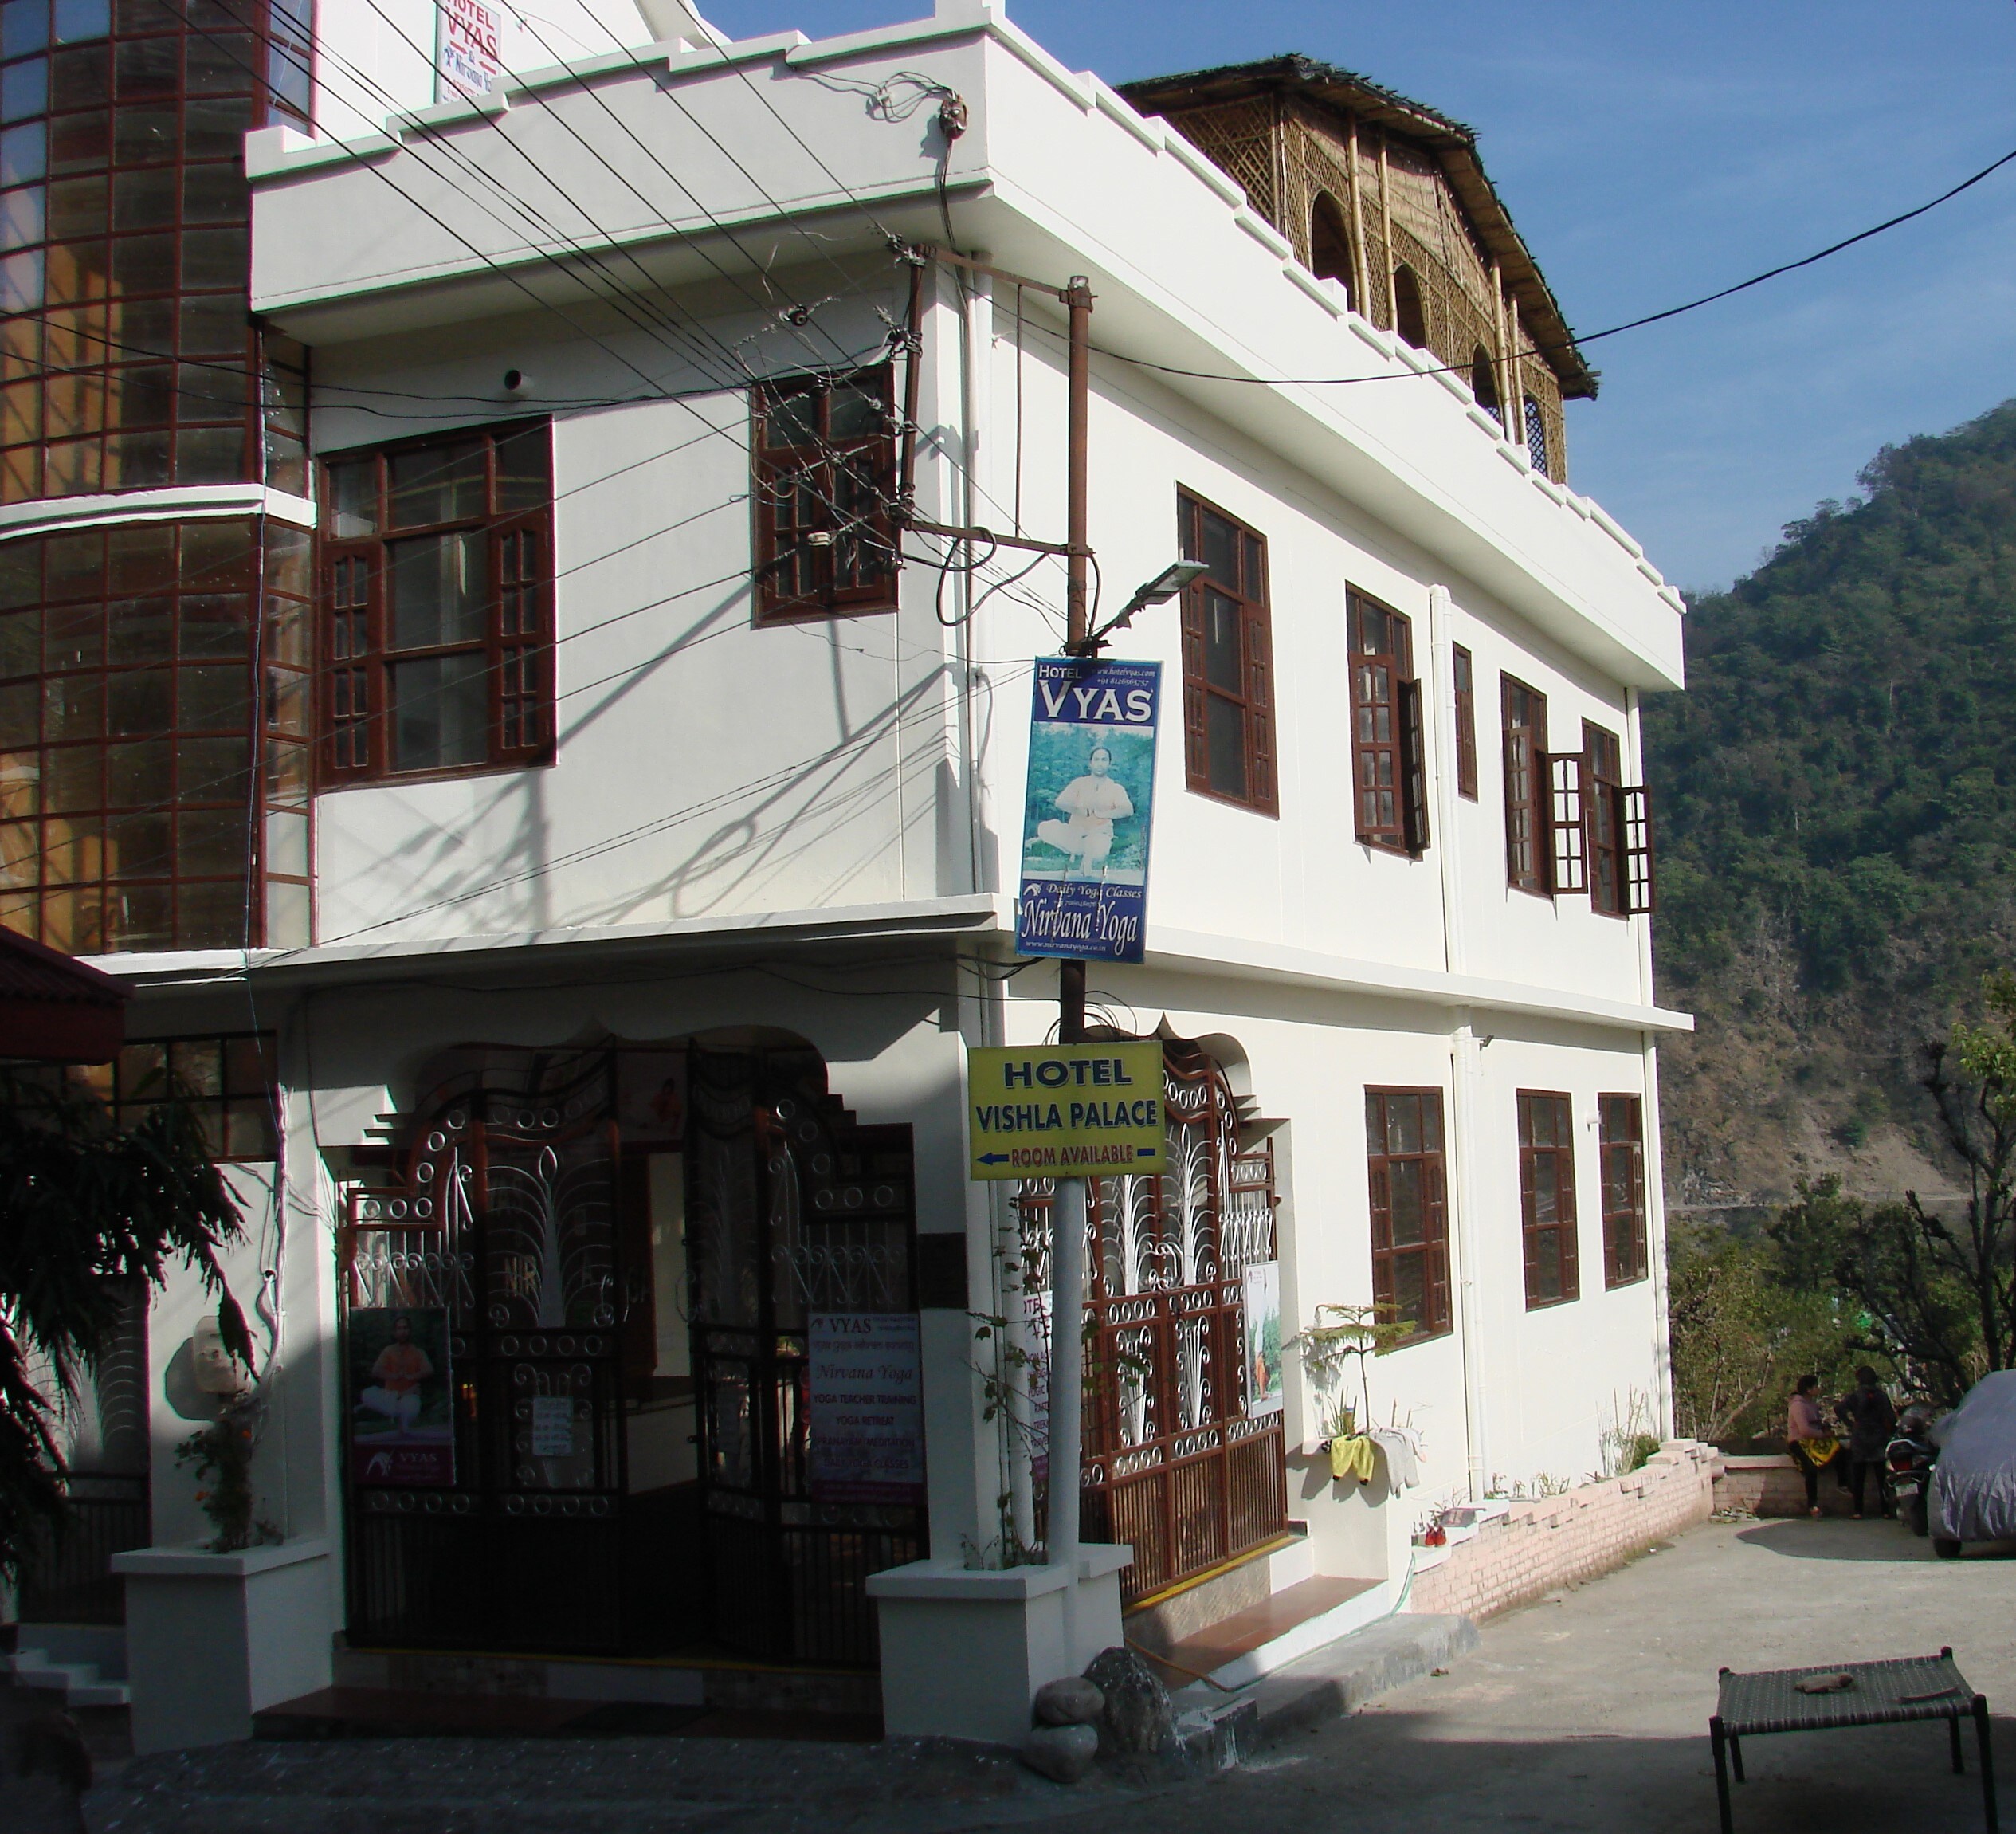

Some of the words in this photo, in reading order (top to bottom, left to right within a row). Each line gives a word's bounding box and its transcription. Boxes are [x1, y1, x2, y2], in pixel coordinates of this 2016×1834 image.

[448, 0, 495, 31] OTEL
[445, 5, 497, 62] VYAS
[1038, 664, 1083, 679] HOTEL
[1038, 679, 1153, 723] VYAS
[1046, 882, 1076, 897] Daily
[1078, 884, 1102, 900] Yoga
[1106, 886, 1143, 899] Classes
[1021, 897, 1092, 939] Nirvana
[1099, 900, 1139, 956] Yoga
[1003, 1058, 1133, 1089] HOTEL
[975, 1103, 1065, 1133] VISHLA
[1069, 1099, 1158, 1129] PALACE
[1011, 1146, 1056, 1168] ROOM
[1060, 1144, 1134, 1166] AVAILABLE
[830, 1318, 872, 1333] VYAS
[816, 1364, 873, 1380] Nirvana
[879, 1364, 912, 1384] Yoga
[814, 1394, 837, 1404] YOGA
[840, 1394, 875, 1404] TEACHER
[877, 1395, 916, 1404] TRAINING
[836, 1416, 860, 1425] YOGA
[862, 1416, 894, 1425] RETREAT
[399, 1452, 437, 1463] VYAS
